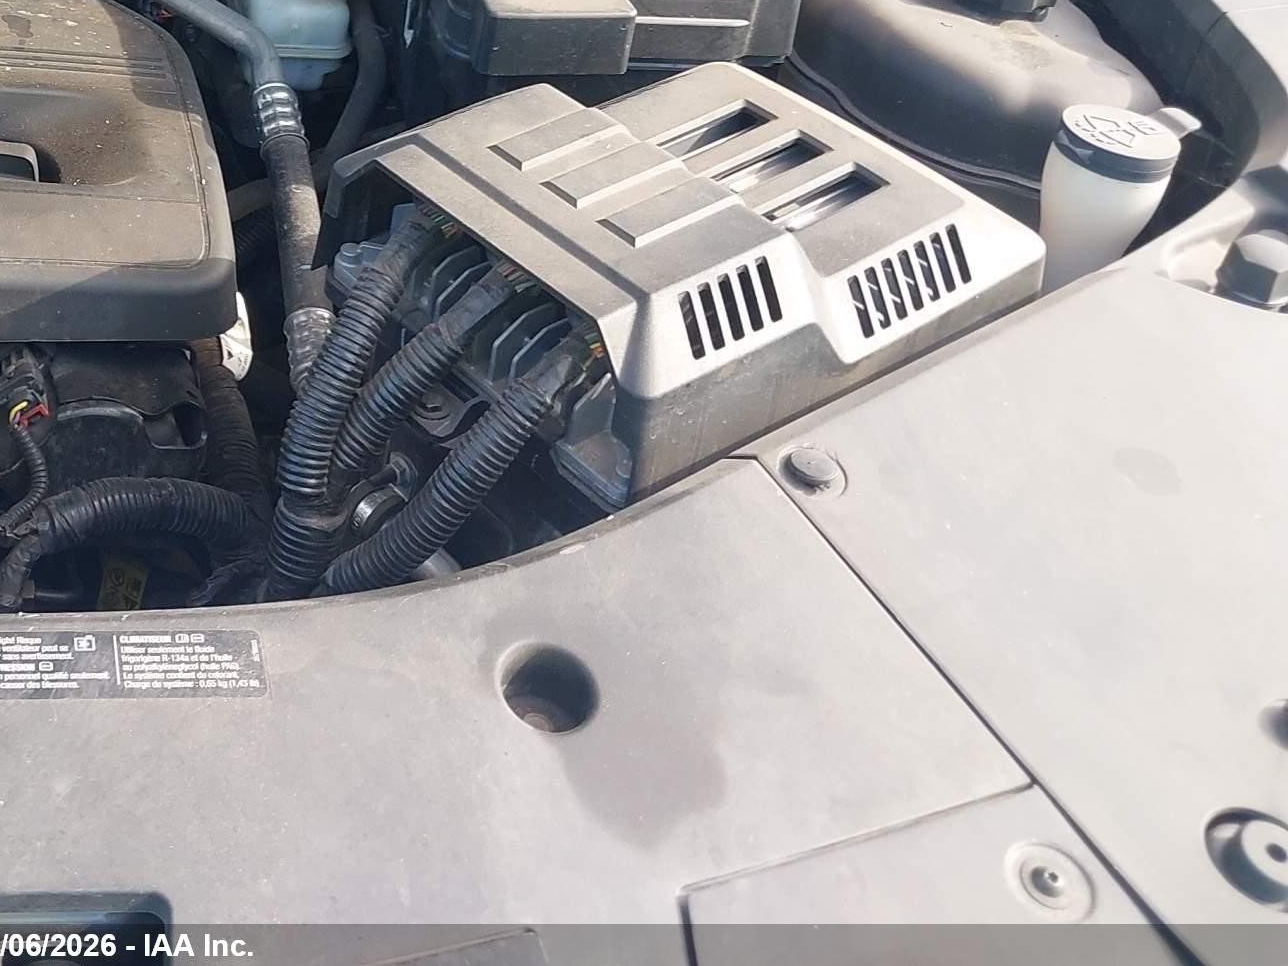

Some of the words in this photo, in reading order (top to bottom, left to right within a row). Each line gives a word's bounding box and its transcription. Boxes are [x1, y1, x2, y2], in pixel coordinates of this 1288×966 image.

[16, 637, 41, 645] Risque
[41, 644, 58, 652] peut
[4, 673, 41, 681] personnel
[124, 681, 151, 689] Charge
[162, 680, 194, 689] système
[217, 680, 228, 688] kg
